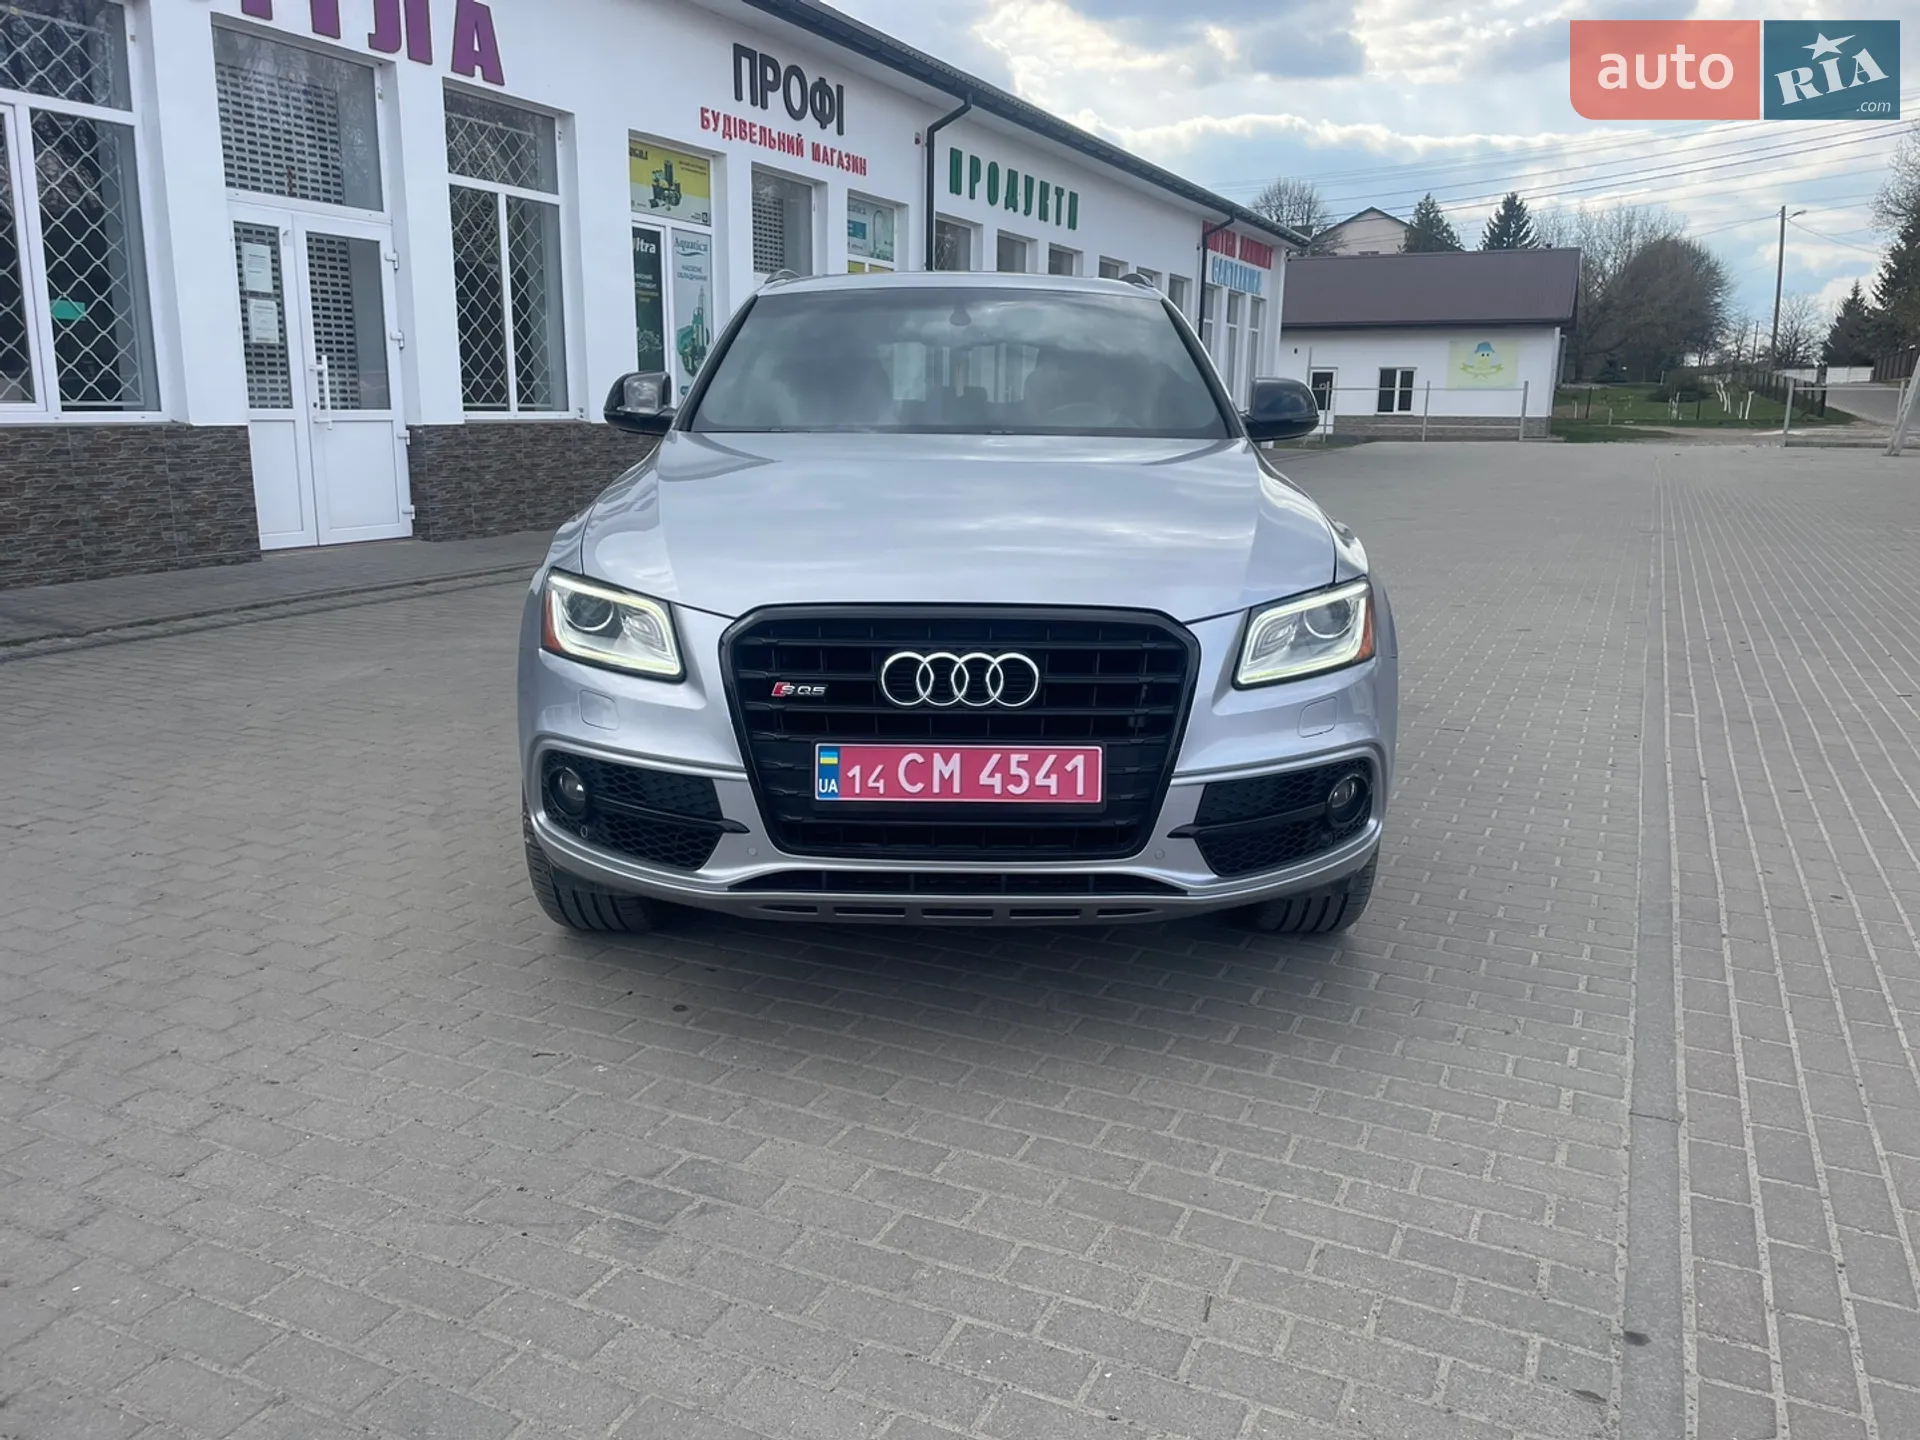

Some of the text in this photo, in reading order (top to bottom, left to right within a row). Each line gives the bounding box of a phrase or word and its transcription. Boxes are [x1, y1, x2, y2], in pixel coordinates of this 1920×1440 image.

[241, 0, 505, 87] ЛА
[733, 42, 844, 136] ПРОФІ
[700, 106, 867, 177] БУДІВЕЛЬНИЙ МАГАЗИН
[949, 146, 1079, 231] ПРОДУКТИ
[674, 236, 708, 252] Aquatica
[771, 681, 826, 697] SQ5
[819, 778, 838, 793] UA
[847, 752, 1086, 796] 14 CM 4541
